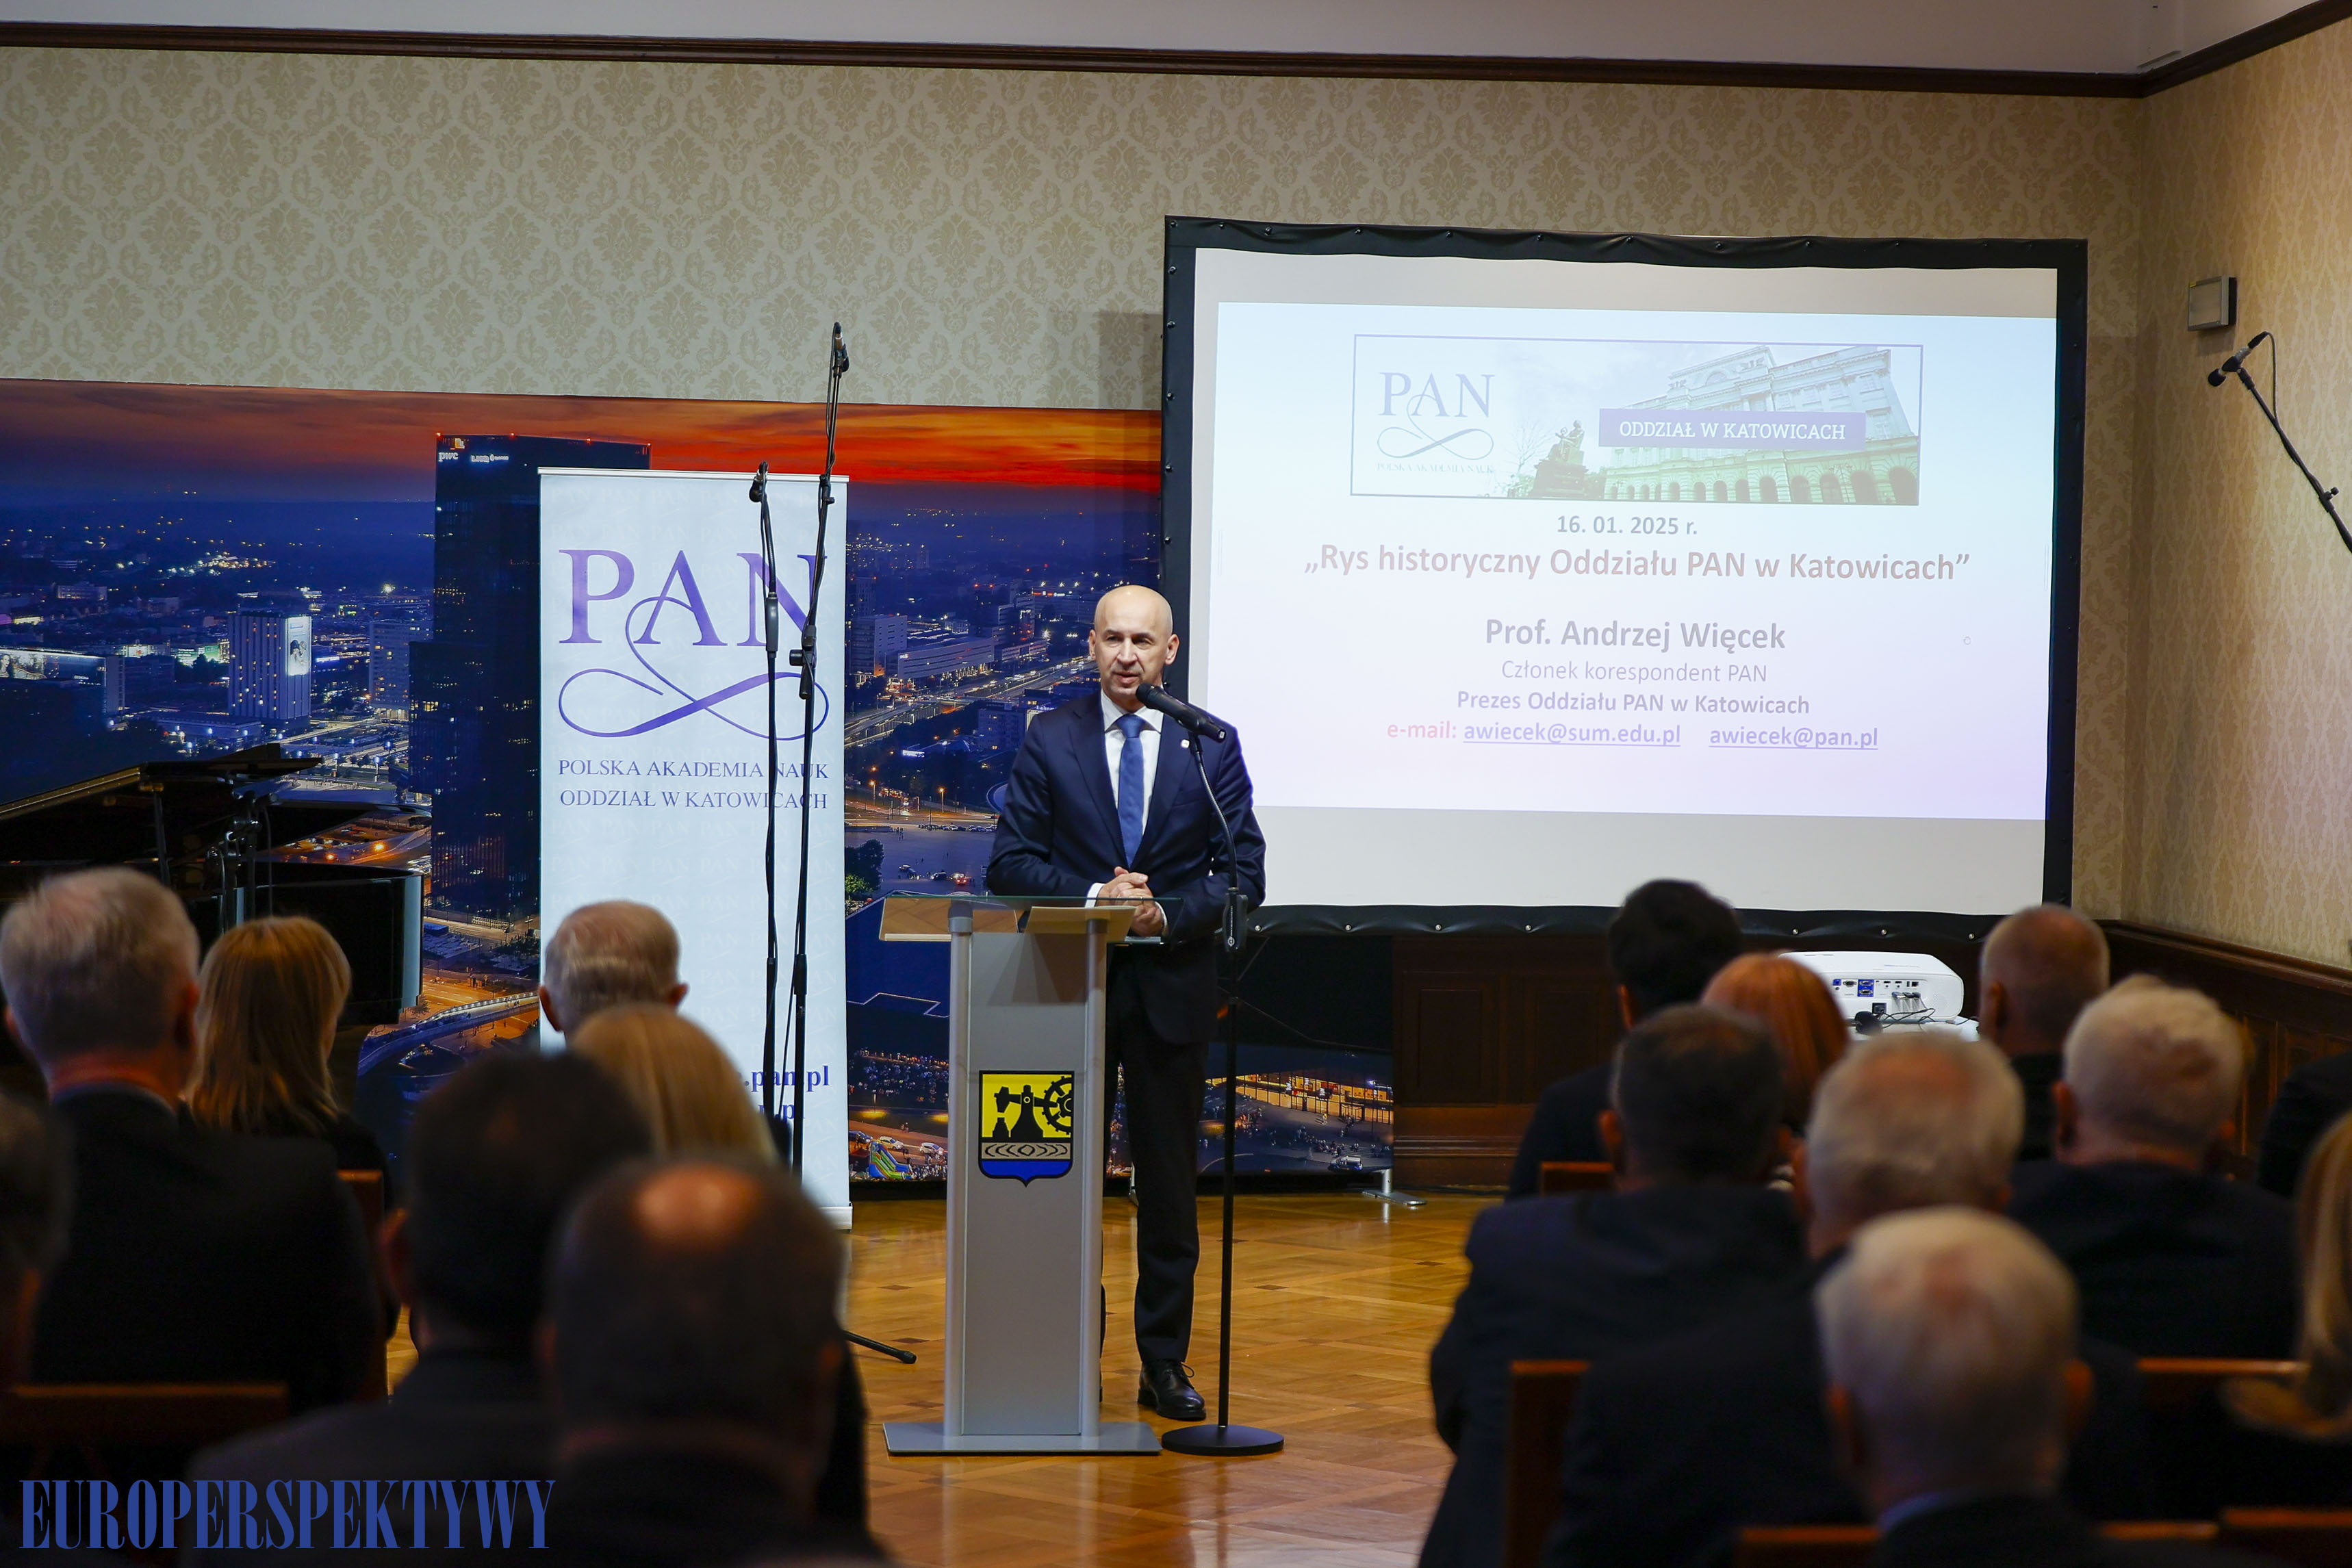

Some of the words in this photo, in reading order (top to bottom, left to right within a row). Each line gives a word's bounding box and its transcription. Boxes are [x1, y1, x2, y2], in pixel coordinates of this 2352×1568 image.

[1377, 372, 1495, 417] PAN
[1619, 421, 1696, 438] ODDZIAŁ
[1700, 422, 1719, 438] W
[1724, 423, 1846, 439] KATOWICACH
[1557, 515, 1586, 533] 16.
[1593, 516, 1623, 534] 01.
[1631, 517, 1679, 535] 2025
[1686, 521, 1698, 535] r.
[1303, 544, 1369, 576] „Rys
[1379, 544, 1541, 580] historyczny
[1550, 549, 1677, 576] Oddziału
[1687, 552, 1746, 577] PAN
[1754, 558, 1780, 578] w
[559, 550, 829, 647] PAN
[1486, 619, 1551, 645] Prof.
[1560, 620, 1671, 653] Andrzej
[1680, 622, 1786, 654] Więcek
[1502, 660, 1578, 680] Członek
[1585, 660, 1722, 684] korespondent
[1728, 664, 1767, 682] PAN
[1457, 691, 1522, 709] Prezes
[1528, 691, 1617, 711] Oddziału
[1623, 694, 1664, 712] PAN
[1671, 698, 1689, 712] w
[1695, 695, 1810, 714] Katowicach
[1387, 721, 1457, 738] e-mail:
[1463, 722, 1680, 747] awiecek@sum.edu.pl
[1709, 726, 1878, 749] awiecek@pan.pl
[559, 760, 641, 776] POLSKA
[647, 761, 765, 778] AKADEMIA
[560, 789, 656, 807] ODDZIAŁ
[661, 791, 680, 808] W
